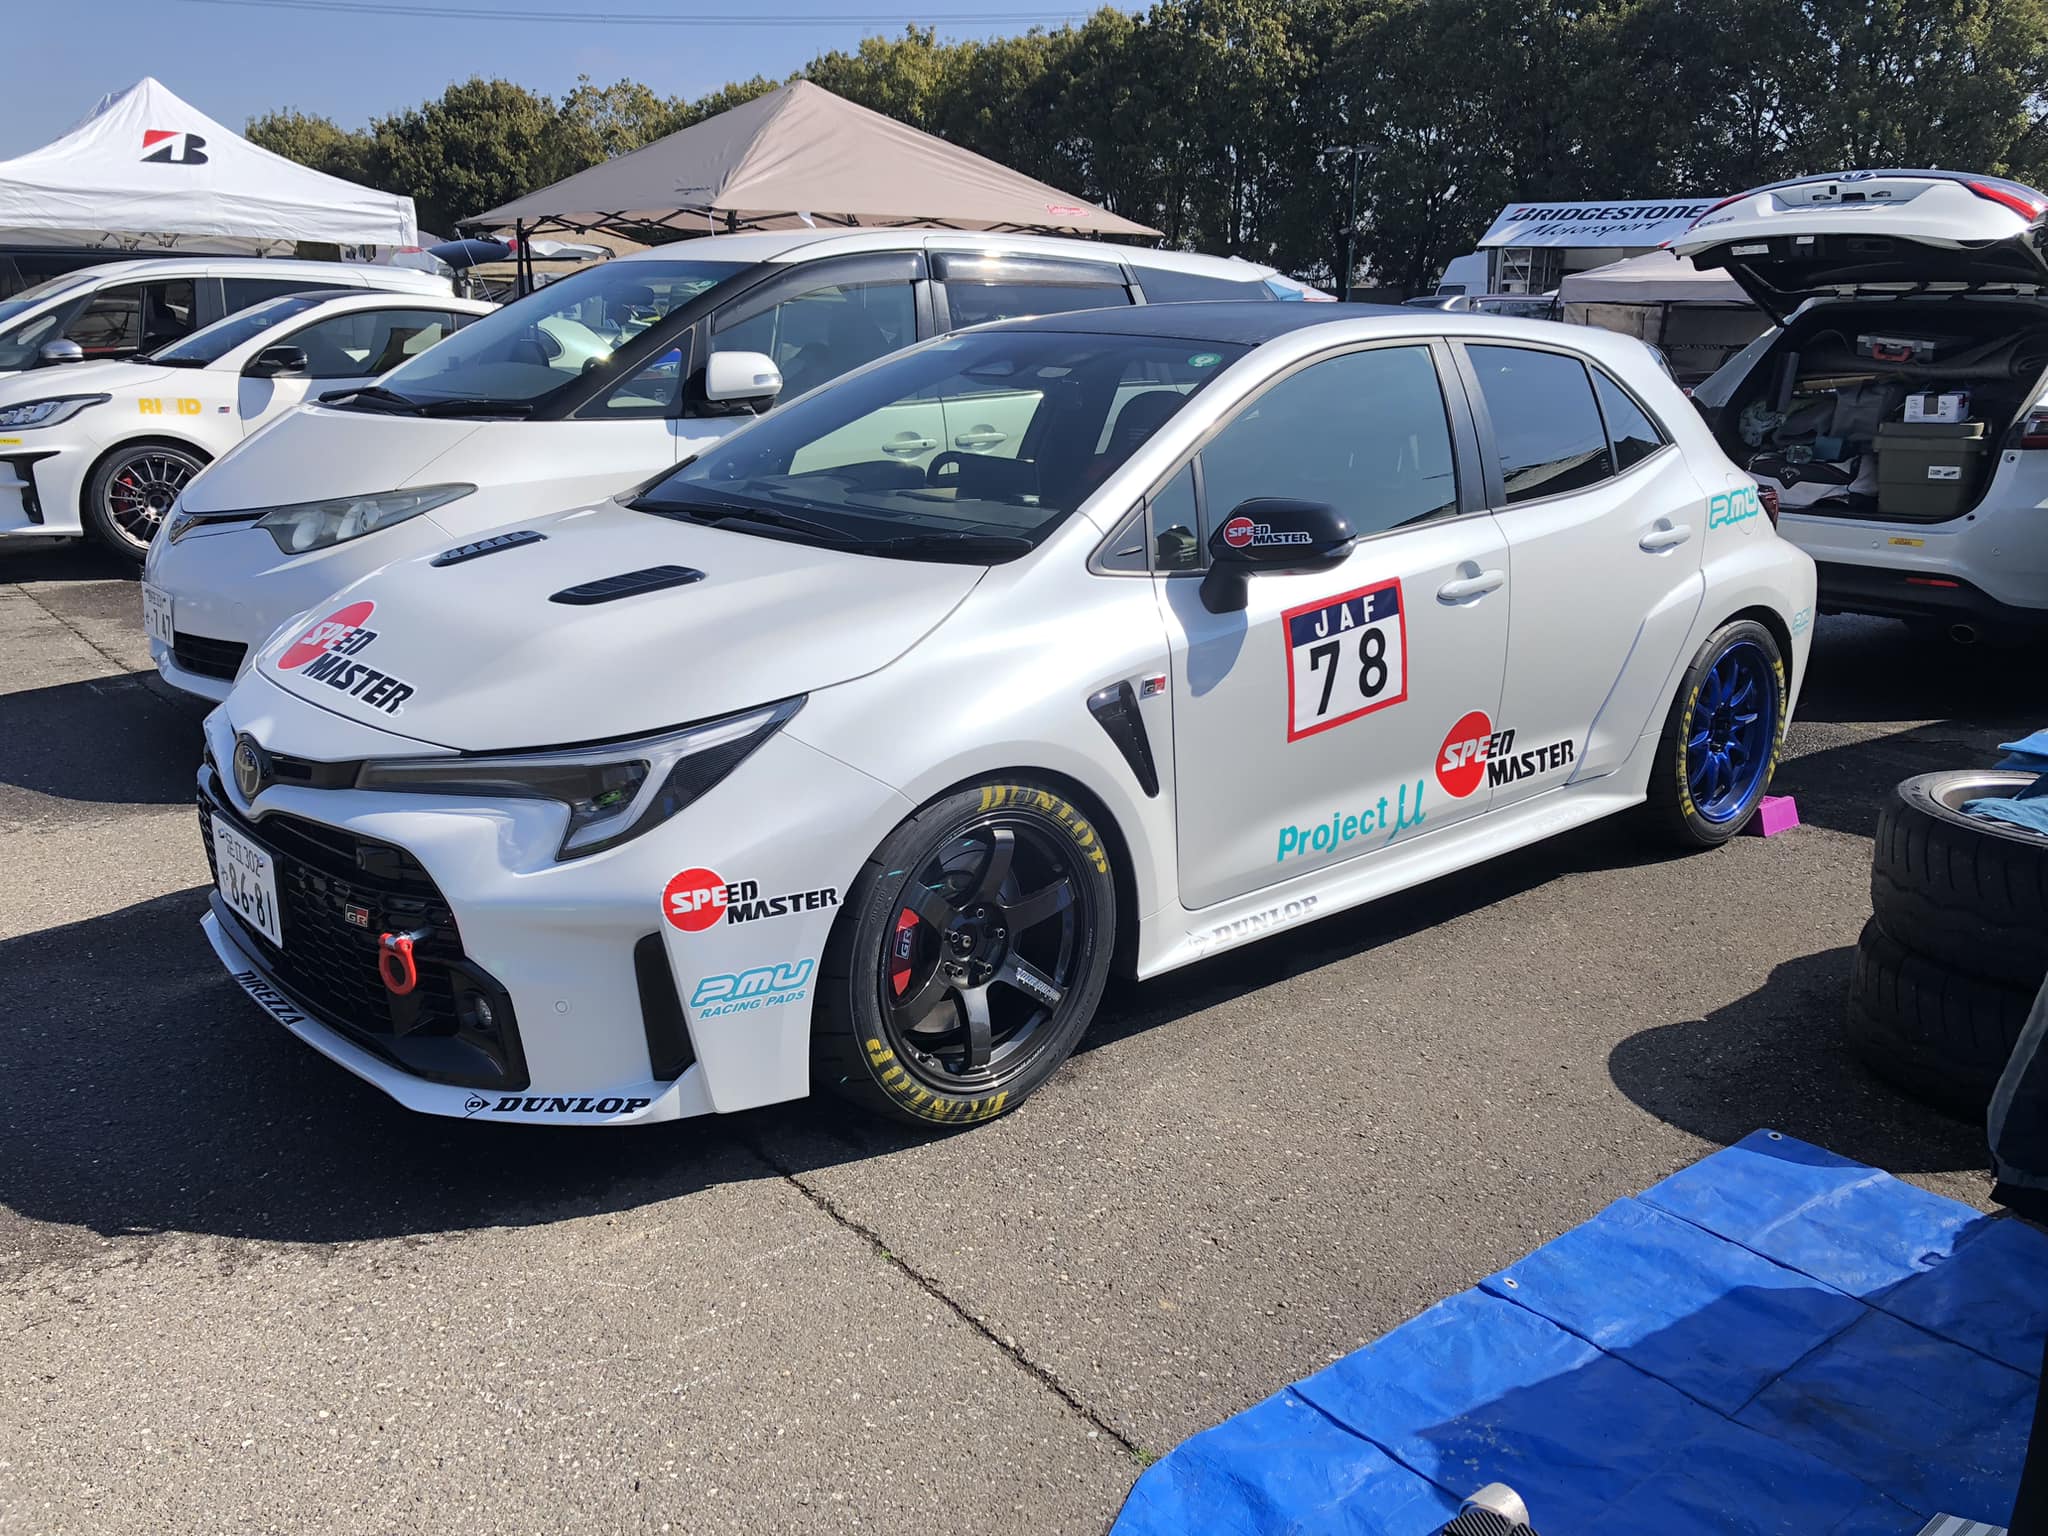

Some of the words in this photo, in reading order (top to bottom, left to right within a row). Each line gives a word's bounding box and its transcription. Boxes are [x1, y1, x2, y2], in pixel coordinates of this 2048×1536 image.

[1506, 205, 1709, 222] BRIDGESTONE
[1509, 220, 1674, 243] Motorsport
[1228, 525, 1269, 538] SPEED
[1253, 533, 1309, 545] MASTER
[1314, 594, 1375, 638] JAF
[301, 621, 378, 656] SPEED
[301, 652, 415, 714] MASTER
[1310, 627, 1388, 716] 78
[1441, 728, 1516, 773] SPEED
[1487, 739, 1574, 788] MASTER
[229, 862, 275, 937] 86-81
[670, 880, 759, 914] SPEED
[727, 888, 839, 925] MASTER
[346, 910, 368, 927] GR
[1212, 895, 1319, 945] DUNLOP
[901, 928, 913, 957] GR
[233, 969, 306, 1026] DIREZZA
[700, 999, 761, 1019] RACING
[766, 990, 806, 1006] PADS
[491, 1097, 652, 1114] DUNLOP
